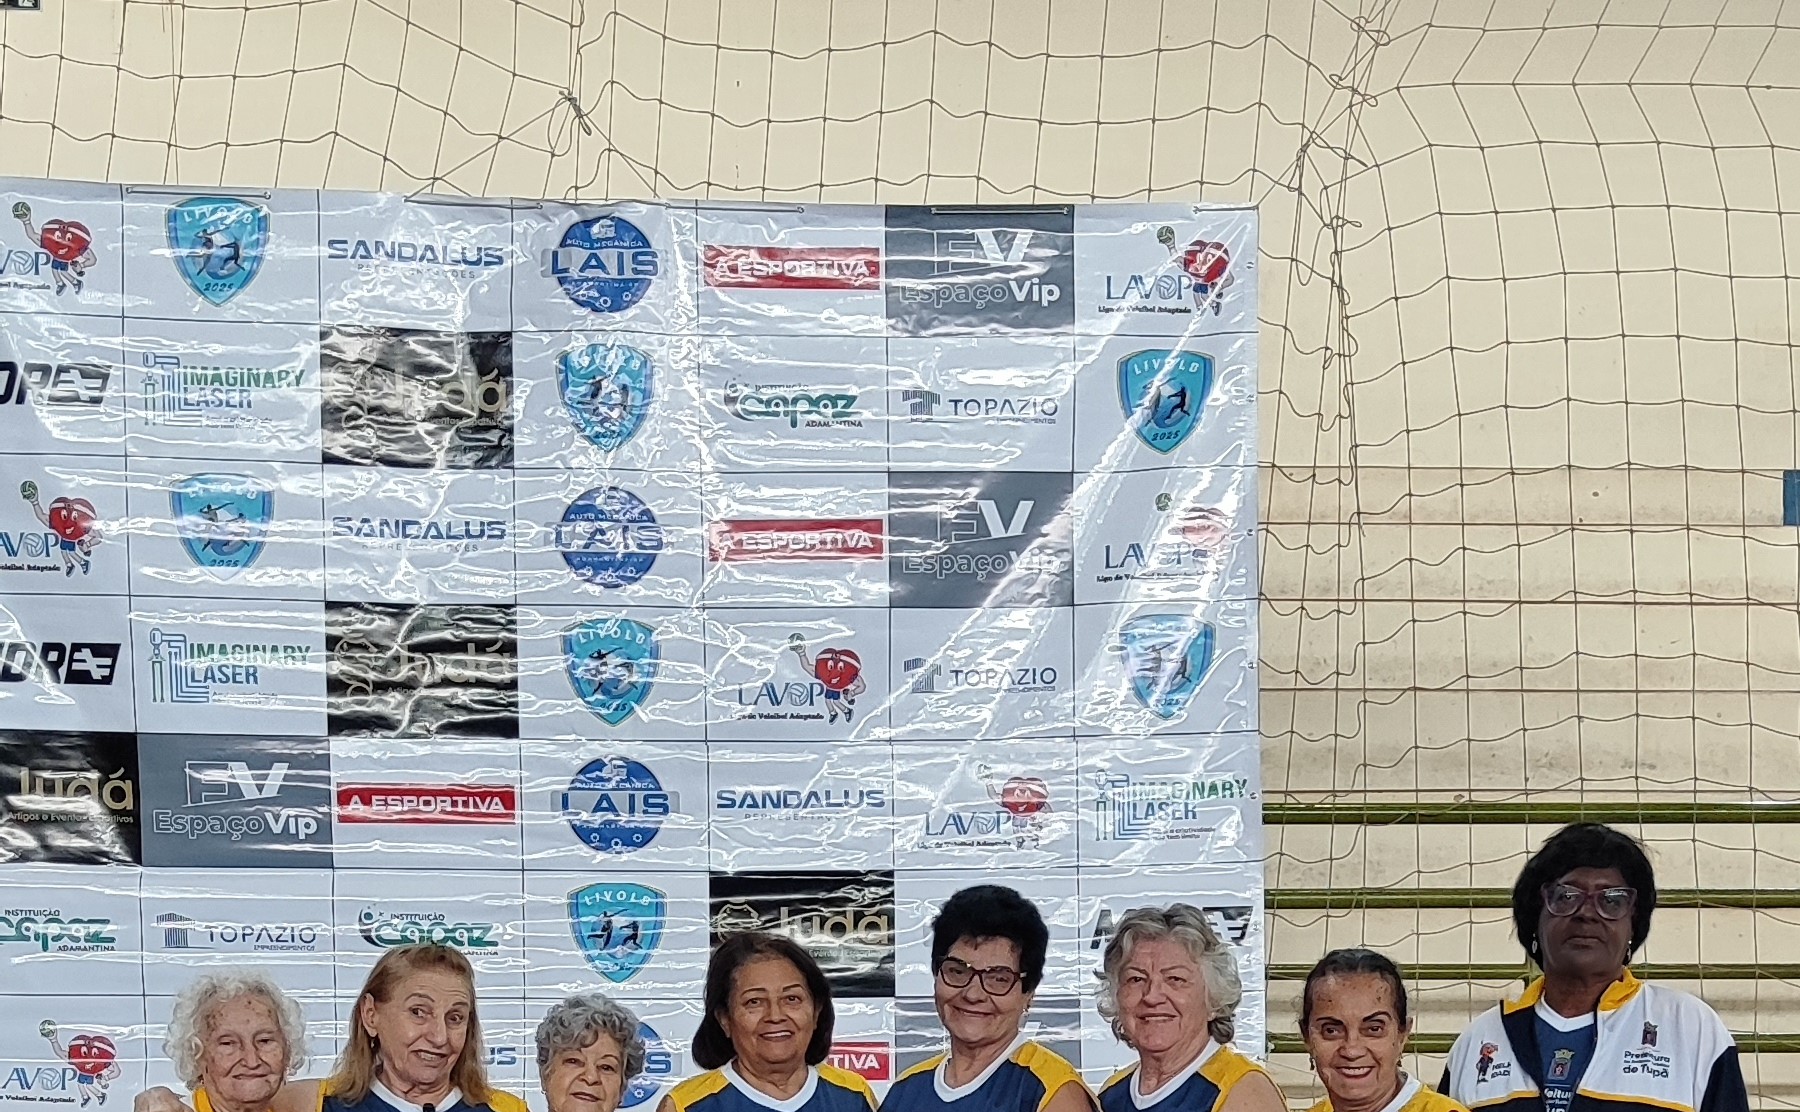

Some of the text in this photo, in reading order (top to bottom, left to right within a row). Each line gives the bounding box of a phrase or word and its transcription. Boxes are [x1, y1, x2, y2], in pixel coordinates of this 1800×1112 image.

[327, 239, 505, 267] SANDALUS
[551, 250, 659, 276] LAIS
[737, 260, 871, 277] ESPORTIVA
[203, 282, 235, 293] 2025
[183, 365, 306, 389] IMAGINARY
[183, 386, 253, 409] LASER
[1151, 430, 1181, 441] 2025
[332, 516, 507, 540] SANDALUS
[742, 532, 874, 549] ESPORTIVA
[190, 643, 311, 666] IMAGINARY
[190, 664, 259, 685] LASER
[738, 682, 824, 706] LAVOP
[349, 795, 506, 813] A ESPORTIVA
[561, 792, 670, 818] LAIS
[716, 789, 886, 810] SANDALUS
[1132, 801, 1198, 821] LASER
[925, 810, 1012, 835] LAVOP
[1623, 1065, 1638, 1074] de
[1640, 1063, 1670, 1079] Tupã
